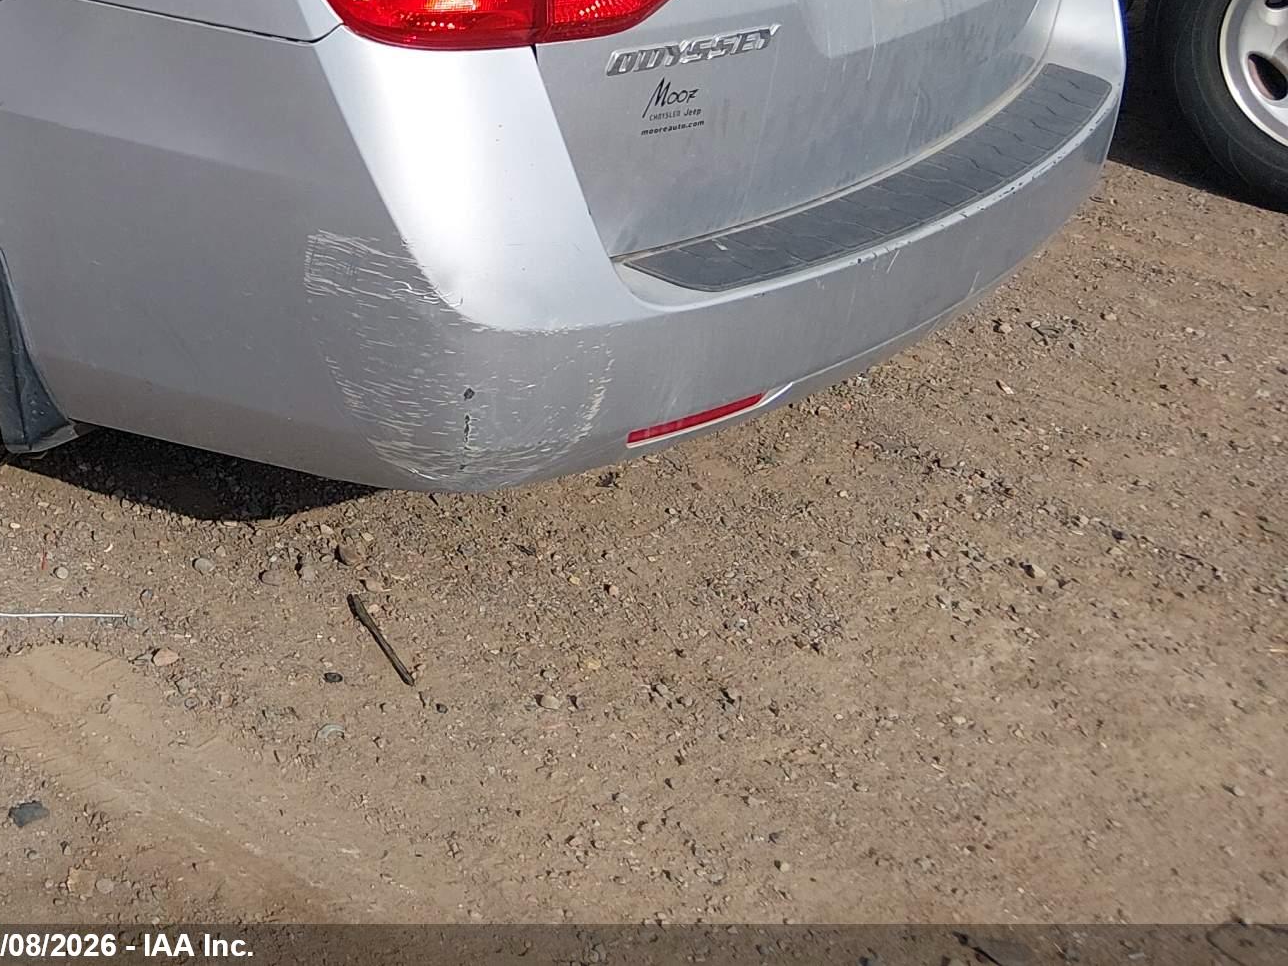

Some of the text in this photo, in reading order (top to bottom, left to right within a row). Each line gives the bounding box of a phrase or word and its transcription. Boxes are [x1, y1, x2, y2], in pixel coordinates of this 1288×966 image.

[606, 23, 782, 76] ODYSSEY
[684, 107, 702, 117] Jeep
[641, 120, 705, 136] mooreauto.com
